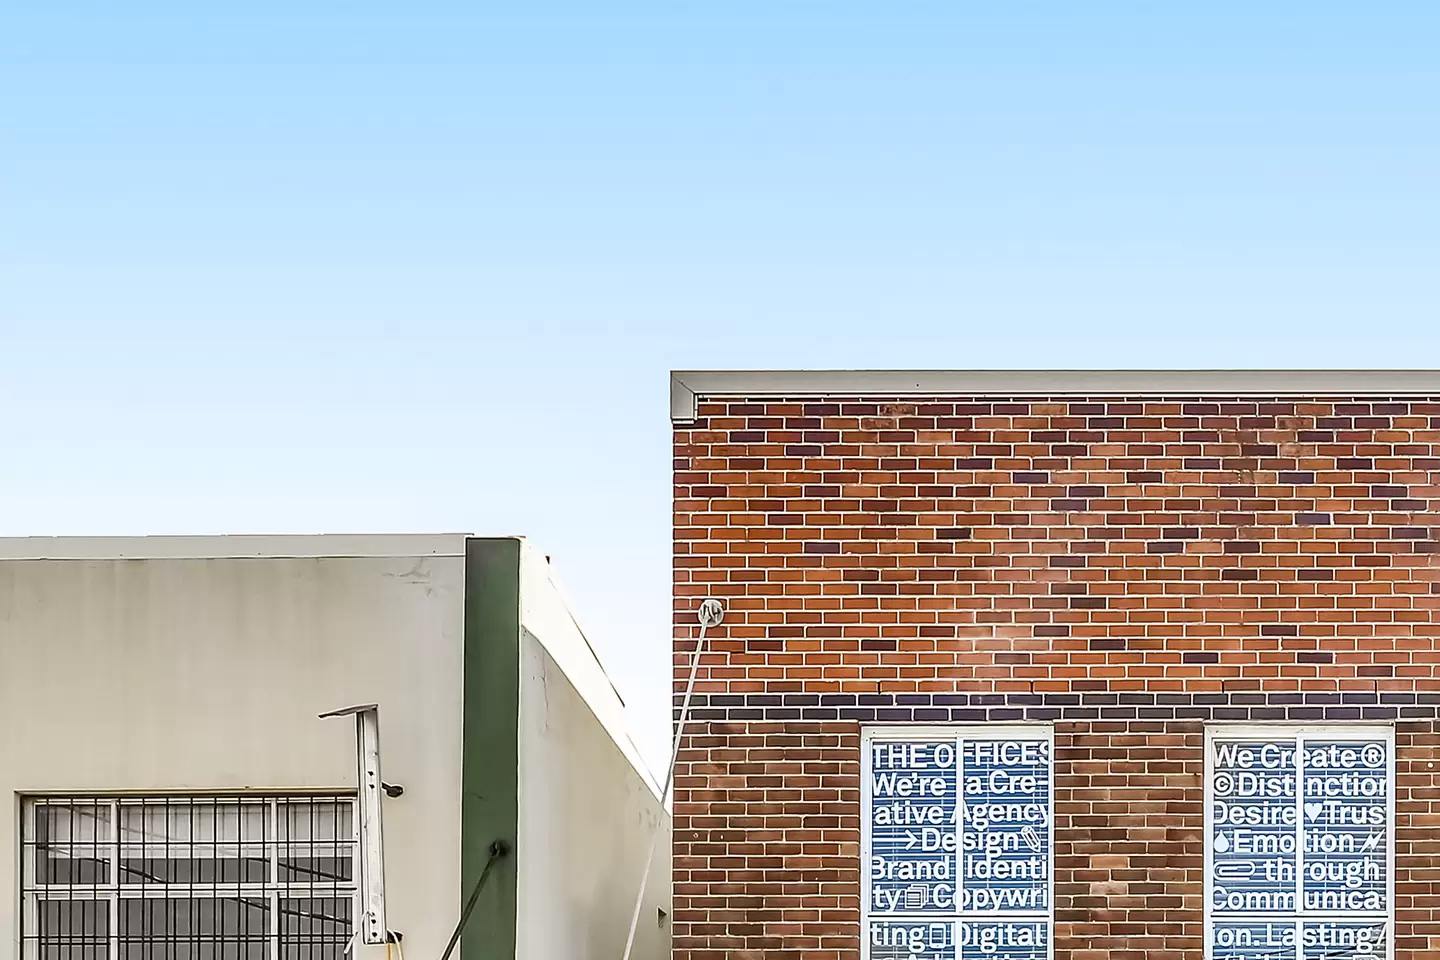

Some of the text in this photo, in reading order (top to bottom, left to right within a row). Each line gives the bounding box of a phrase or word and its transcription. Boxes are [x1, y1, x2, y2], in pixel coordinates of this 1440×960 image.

[873, 744, 927, 768] THE
[1214, 744, 1253, 768] We
[1261, 743, 1356, 768] Create
[966, 777, 982, 794] a
[874, 800, 944, 824] ative
[1214, 801, 1296, 825] Desire
[922, 828, 1018, 858] Design
[1234, 828, 1354, 853] Emotion
[872, 854, 1047, 880] Brand Identi
[1263, 857, 1380, 888] through
[873, 883, 1047, 911] ty Copywri
[871, 922, 1045, 953] ting Digital
[1267, 922, 1373, 953] Lasting
